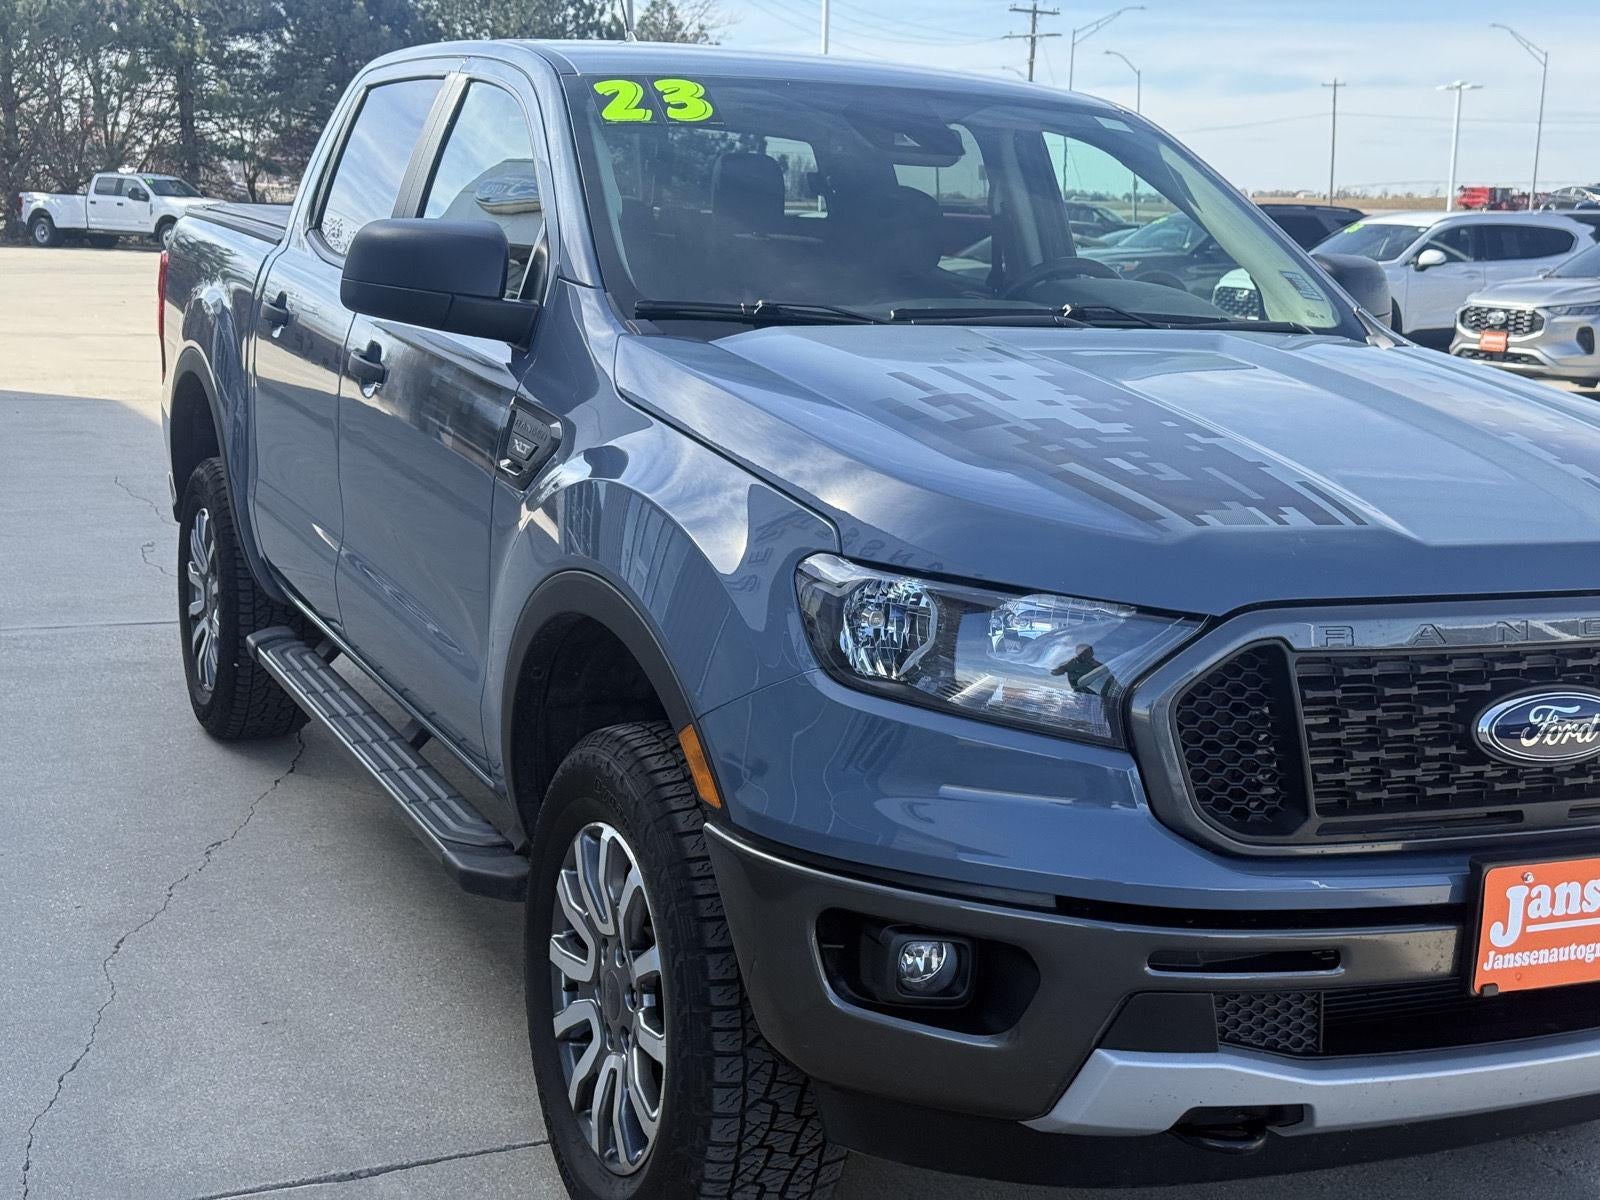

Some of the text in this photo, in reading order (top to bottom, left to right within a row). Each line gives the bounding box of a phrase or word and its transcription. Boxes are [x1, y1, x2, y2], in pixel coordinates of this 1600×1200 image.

[593, 79, 713, 121] 23
[512, 438, 531, 455] XLT
[1520, 704, 1600, 747] Ford
